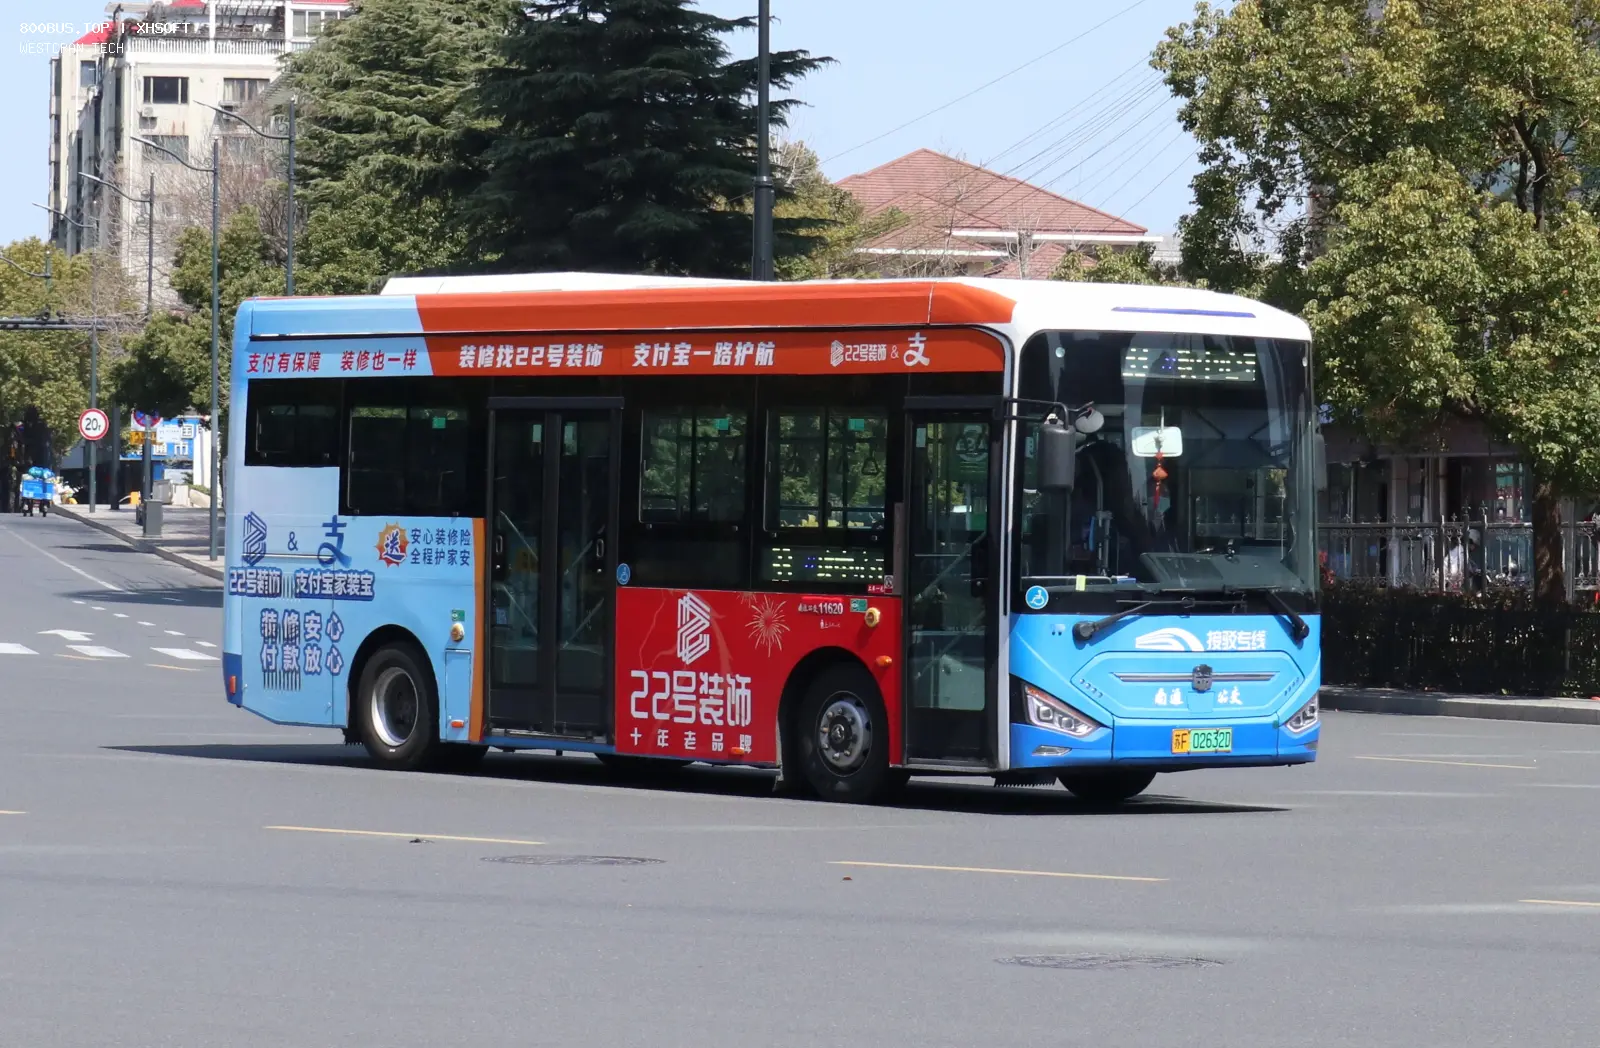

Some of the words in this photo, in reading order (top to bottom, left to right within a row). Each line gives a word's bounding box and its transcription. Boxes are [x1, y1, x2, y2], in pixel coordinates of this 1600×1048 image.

[247, 351, 321, 373] 支付有保障
[340, 349, 417, 371] 装修也一样
[458, 344, 604, 368] 装修找22号装饰
[631, 341, 776, 367] 支付宝一路护航
[383, 529, 407, 563] 送
[410, 528, 471, 546] 安心装修险
[410, 547, 471, 566] 全程护家安
[294, 568, 374, 598] 支付宝家装宝
[260, 608, 345, 643] 装修安心
[1206, 631, 1266, 650] 接驳专线
[260, 643, 344, 676] 付款放心
[630, 670, 752, 727] 22号装饰
[630, 728, 752, 754] 十年老品牌
